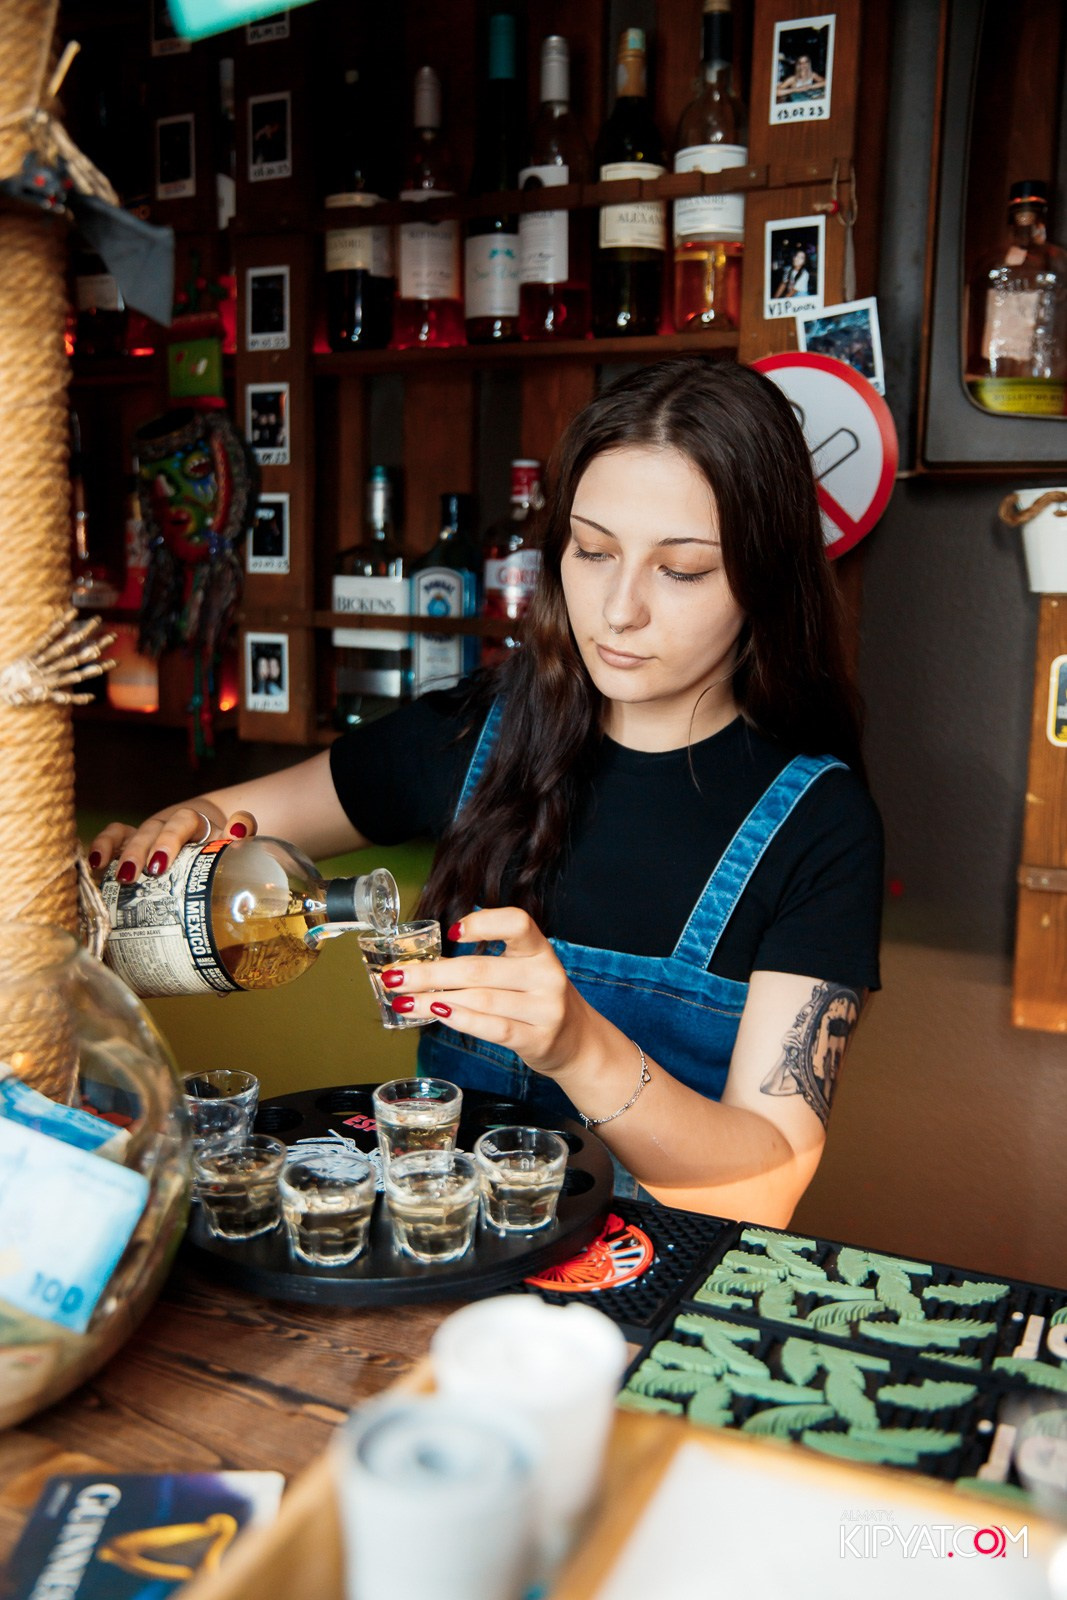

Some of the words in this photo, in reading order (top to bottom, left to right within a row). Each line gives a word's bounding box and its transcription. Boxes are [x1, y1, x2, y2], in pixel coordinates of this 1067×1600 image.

[187, 854, 206, 893] REPOSADO
[197, 853, 216, 891] TEQUILA
[186, 900, 206, 955] MEXICO
